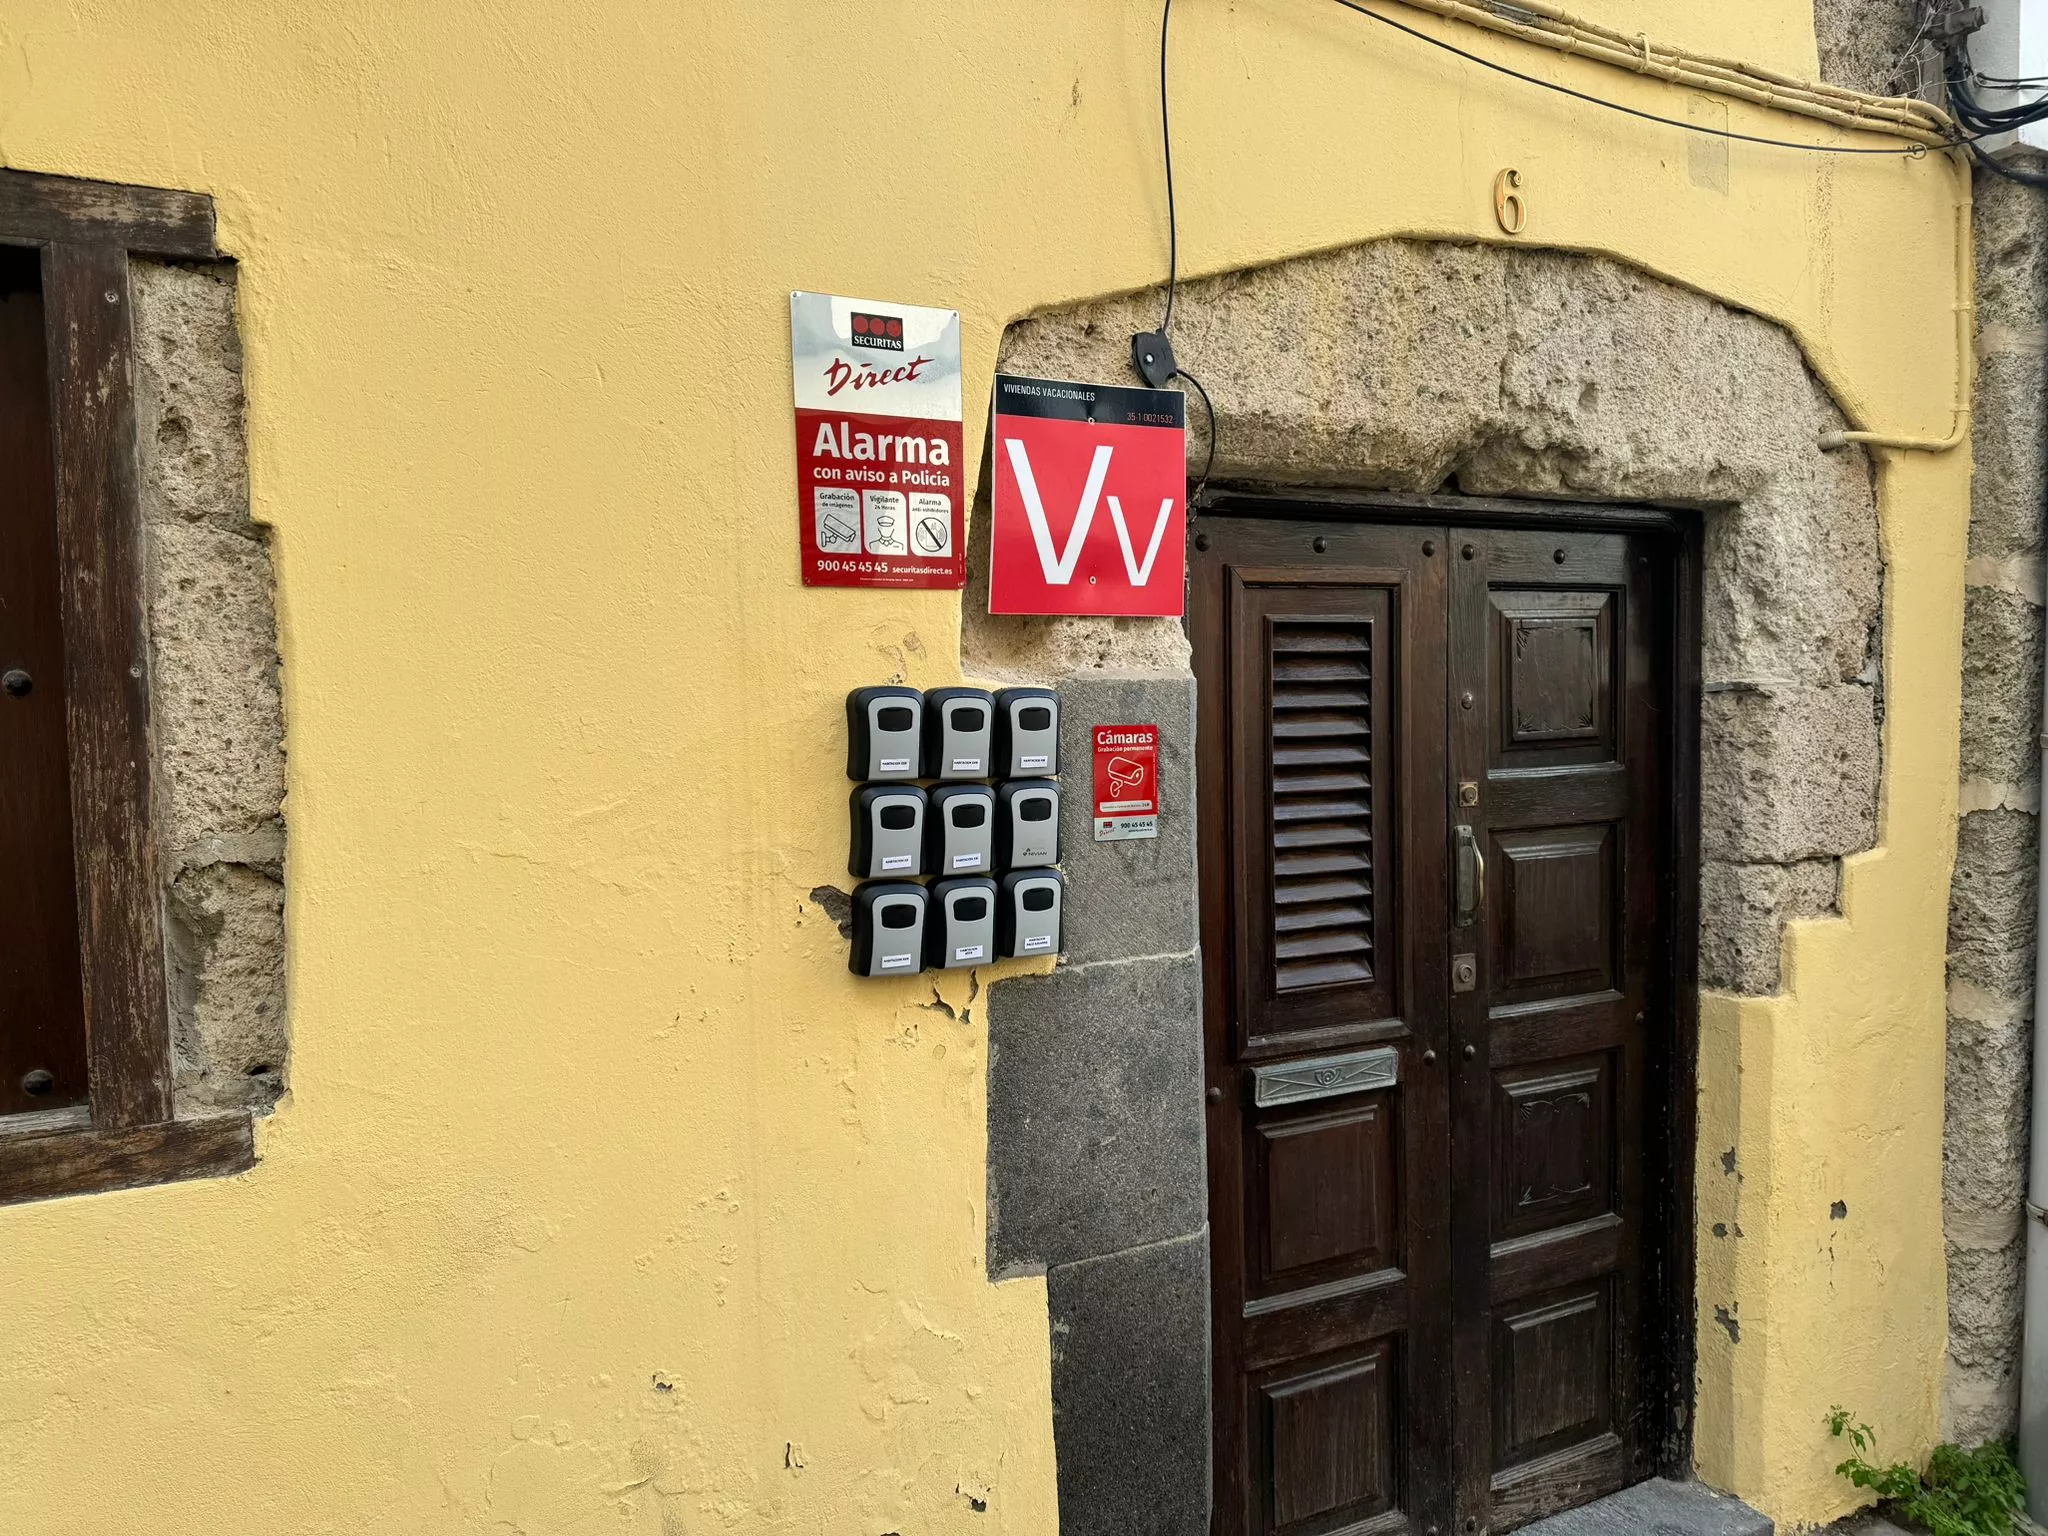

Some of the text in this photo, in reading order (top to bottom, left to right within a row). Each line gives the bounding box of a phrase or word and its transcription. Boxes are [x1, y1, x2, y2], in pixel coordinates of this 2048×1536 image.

[1493, 167, 1527, 235] 6
[853, 335, 903, 350] SECURITAS
[823, 355, 935, 397] Direct
[1003, 383, 1096, 402] VIVIENDAS VACACIONALES
[812, 421, 950, 467] Alarma
[813, 466, 950, 487] con aviso a Policía
[819, 492, 855, 501] Grabación
[869, 495, 900, 504] Vigilante
[918, 498, 942, 506] Alarma
[817, 560, 889, 573] 900 45 45 45
[892, 566, 953, 575] securitasdirect.es
[1097, 730, 1153, 745] Cámaras
[1123, 745, 1153, 753] permanente
